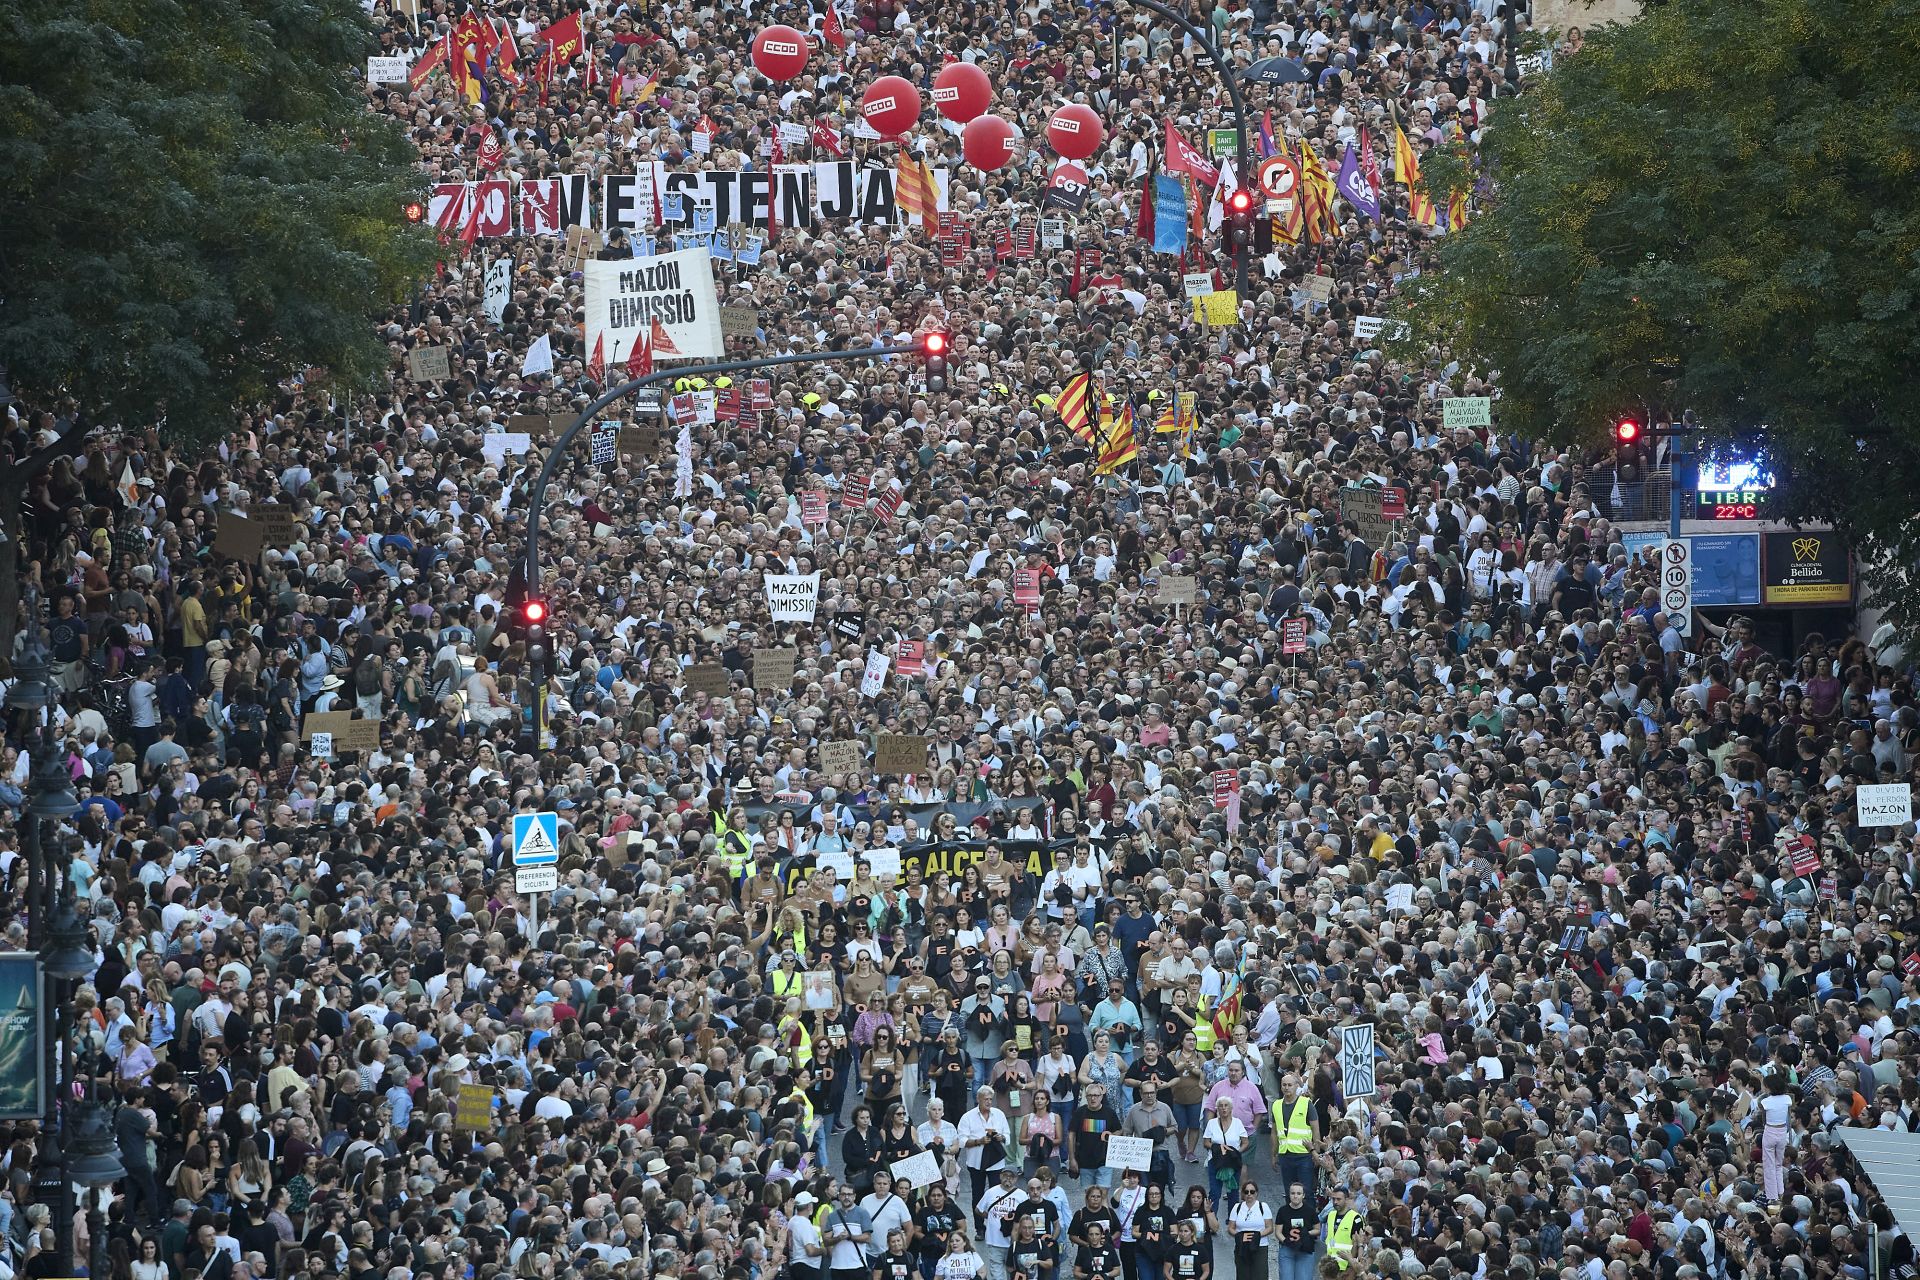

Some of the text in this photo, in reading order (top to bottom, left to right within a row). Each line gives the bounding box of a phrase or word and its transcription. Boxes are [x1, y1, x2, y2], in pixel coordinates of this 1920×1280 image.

[766, 43, 797, 53] CCOO
[865, 100, 893, 114] CCOO
[1053, 119, 1077, 131] CCOO
[1055, 175, 1087, 197] CGT
[619, 260, 680, 293] MAZÓN
[1186, 277, 1207, 285] mazón
[609, 289, 696, 329] DIMISSIÓ
[1445, 399, 1465, 408] MAZÓN
[1449, 408, 1481, 416] MALVADA
[1701, 492, 1764, 504] LIBR
[1669, 572, 1683, 582] 10
[1790, 568, 1823, 577] Bellido
[772, 580, 813, 595] MAZÓN
[770, 595, 817, 613] DIMISSIÓ
[824, 743, 842, 751] VOTAR
[830, 748, 855, 758] MAZÓN
[834, 762, 856, 772] MORT
[1875, 786, 1907, 794] OLVIDO
[517, 871, 556, 880] PREFERENCIA
[523, 881, 550, 889] CICLISTA
[936, 946, 947, 955] E
[913, 1005, 924, 1015] N
[5, 1016, 30, 1024] SHOW
[980, 1012, 992, 1024] N
[1056, 1024, 1069, 1036] D
[1115, 1022, 1126, 1034] A
[823, 1067, 834, 1081] D
[1145, 1231, 1160, 1242] N
[1241, 1232, 1253, 1242] E
[1288, 1230, 1301, 1243] S
[950, 1257, 971, 1268] 20:11
